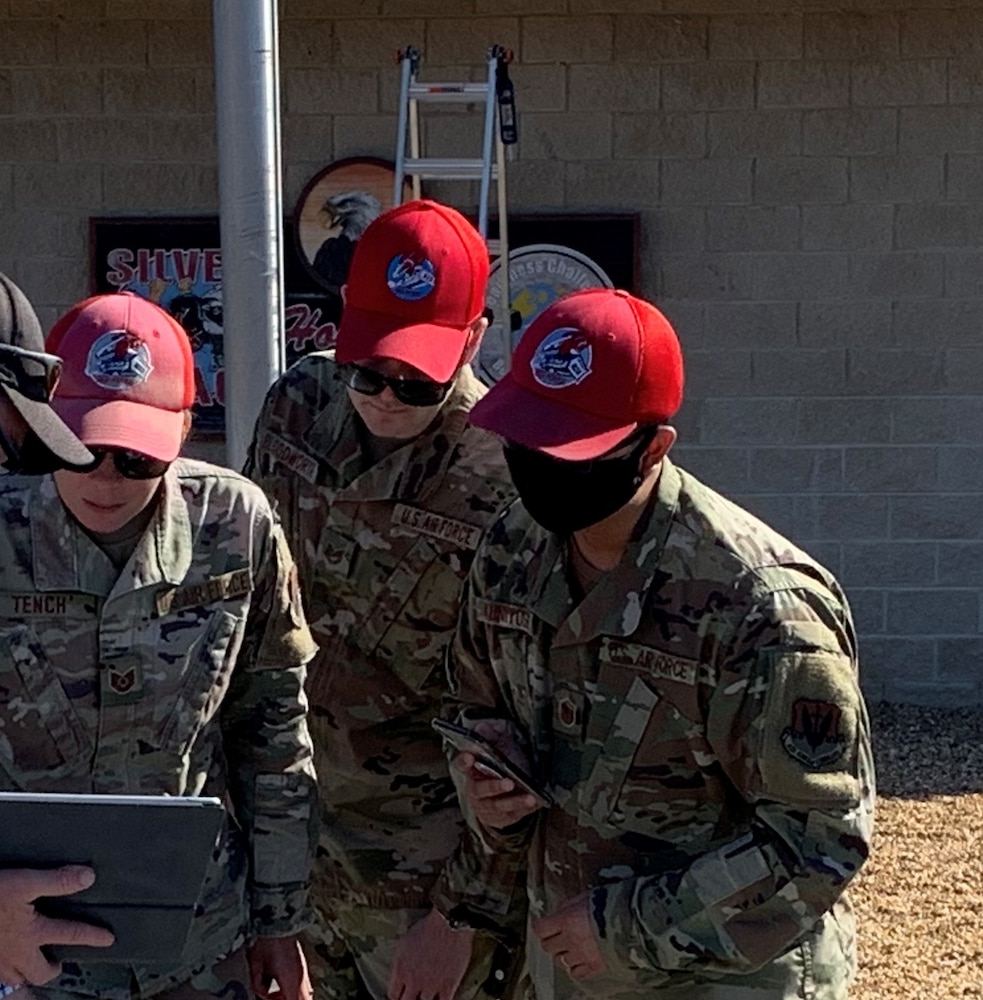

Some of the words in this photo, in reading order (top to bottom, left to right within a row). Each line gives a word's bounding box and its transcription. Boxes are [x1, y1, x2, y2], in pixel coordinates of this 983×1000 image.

[439, 519, 476, 546] FORCE
[11, 594, 66, 614] TENCH
[654, 655, 689, 680] FORCE
